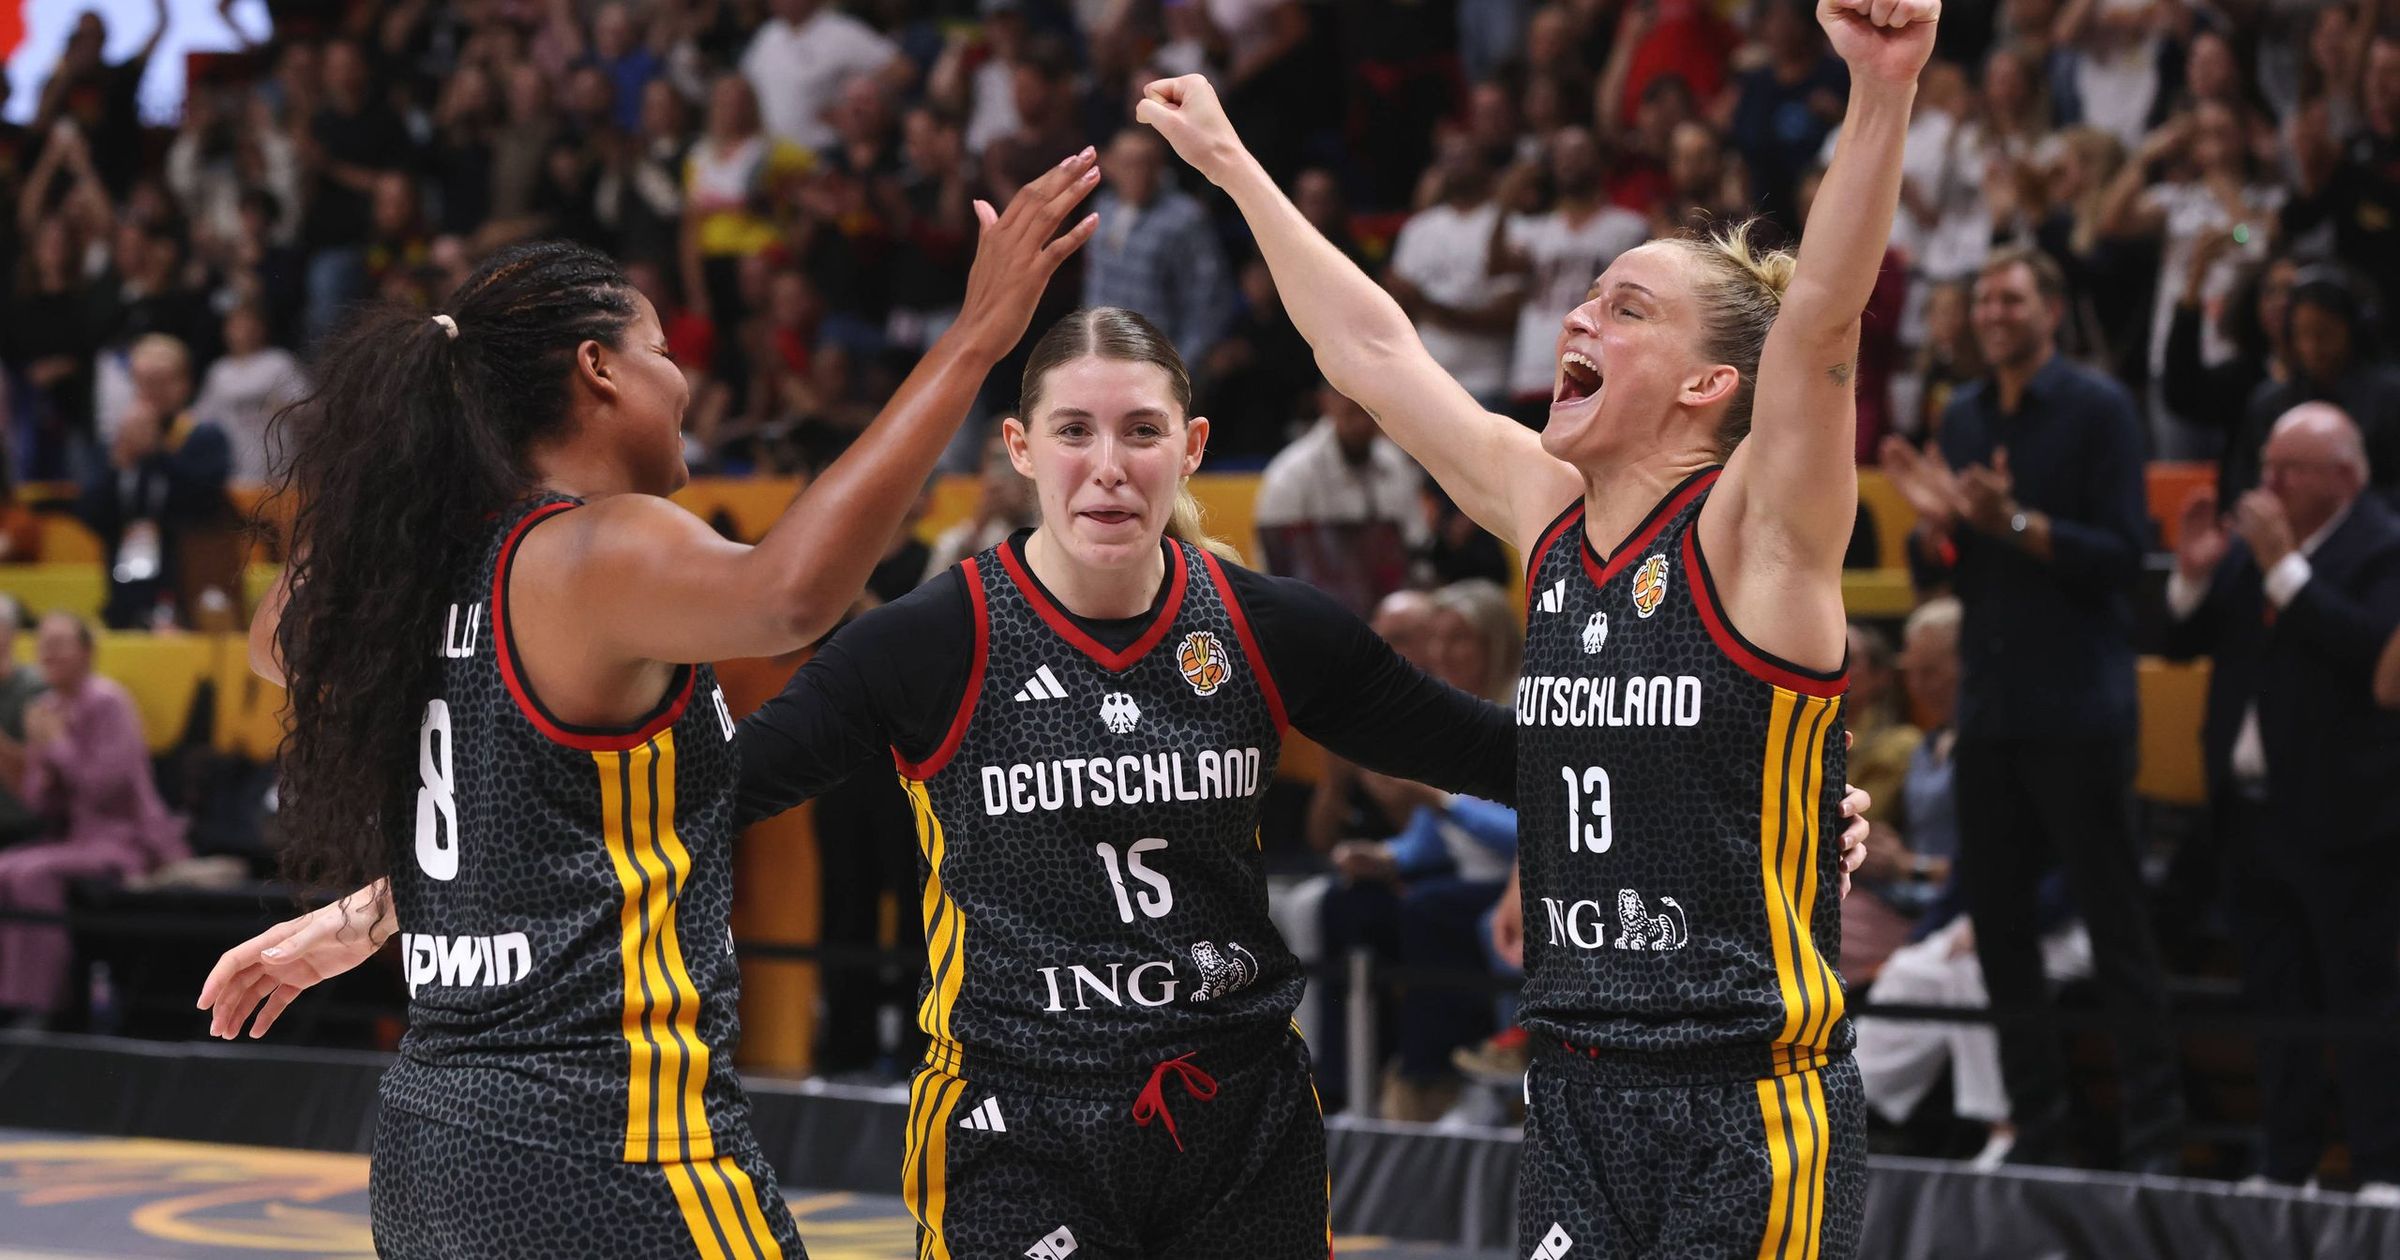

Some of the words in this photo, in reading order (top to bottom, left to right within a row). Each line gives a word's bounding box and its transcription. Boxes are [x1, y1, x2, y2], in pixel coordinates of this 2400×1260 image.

[415, 699, 459, 881] 8
[981, 747, 1260, 816] DEUTSCHLAND
[1562, 766, 1613, 853] 13
[1096, 838, 1173, 923] 15
[1036, 960, 1180, 1012] ING
